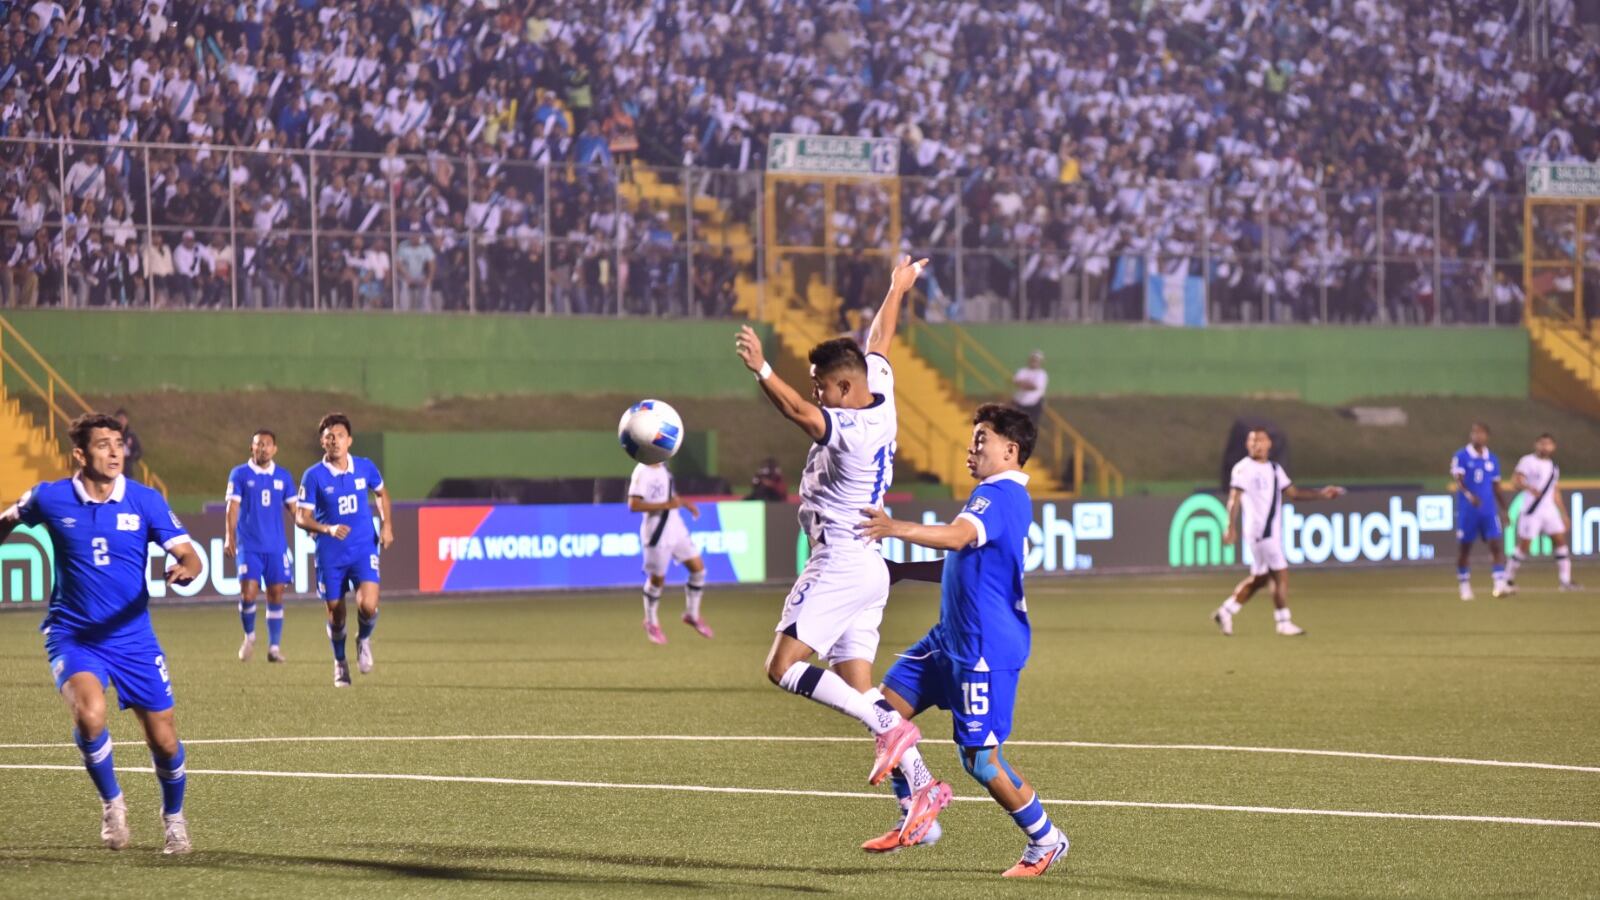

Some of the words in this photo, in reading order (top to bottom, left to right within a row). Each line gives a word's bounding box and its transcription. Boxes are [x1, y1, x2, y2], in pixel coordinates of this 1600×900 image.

[261, 488, 271, 507] 8
[338, 494, 358, 516] 20
[92, 537, 111, 566] 2
[438, 536, 483, 561] FIFA
[484, 534, 558, 560] WORLD
[559, 533, 600, 558] CUP
[155, 654, 170, 683] 2
[962, 682, 989, 715] 15
